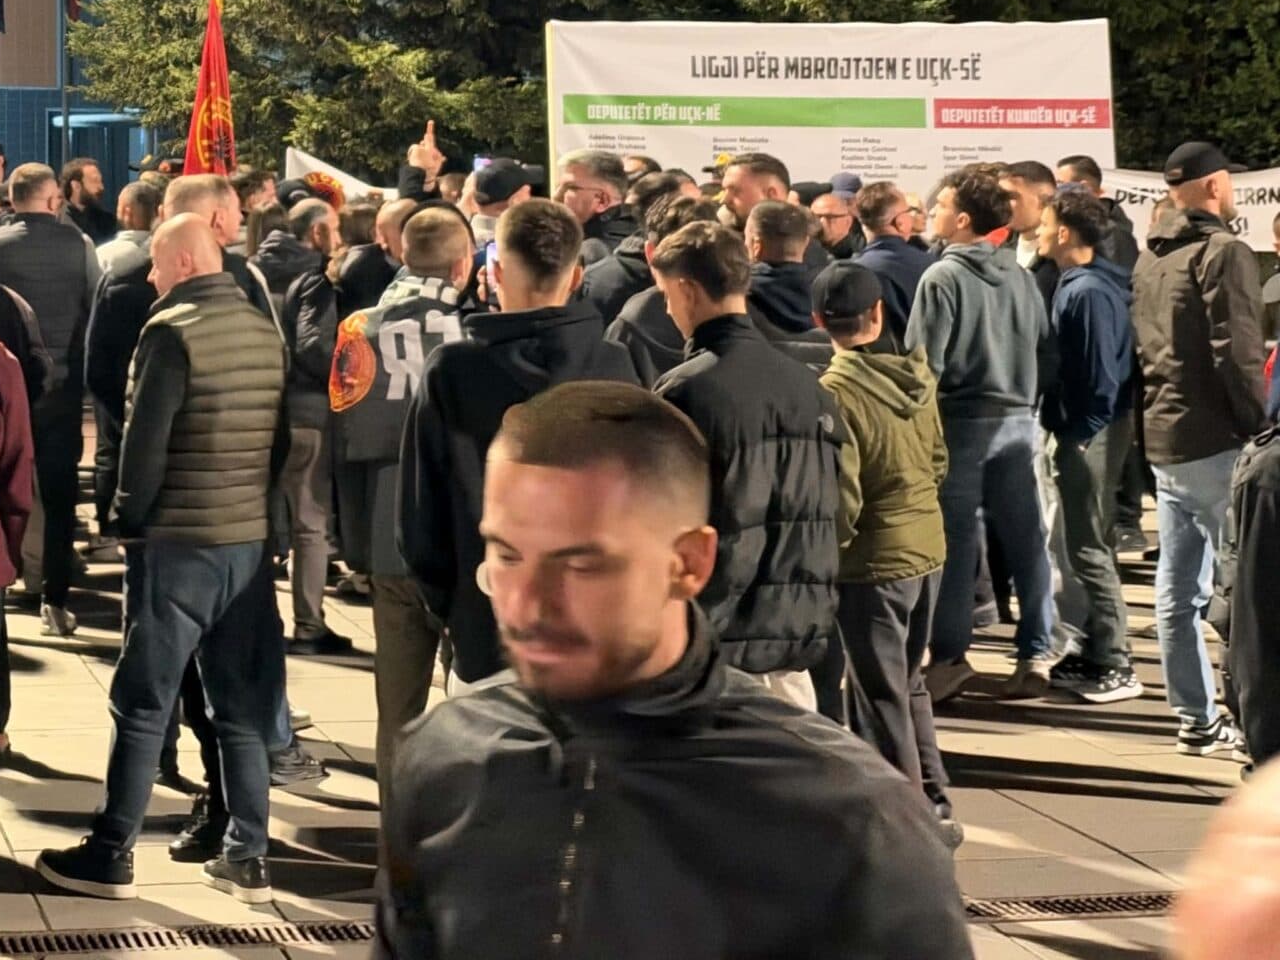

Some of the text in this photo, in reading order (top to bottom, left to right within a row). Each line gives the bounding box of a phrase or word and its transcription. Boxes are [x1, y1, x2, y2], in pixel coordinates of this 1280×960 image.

[691, 51, 982, 87] LIGJI PËR MBROJTJEN E UÇK-SË
[587, 102, 652, 121] DEPUTETËT
[653, 103, 677, 121] PËR
[941, 106, 1096, 127] DEPUTETËT KUNDËR UÇK-SË
